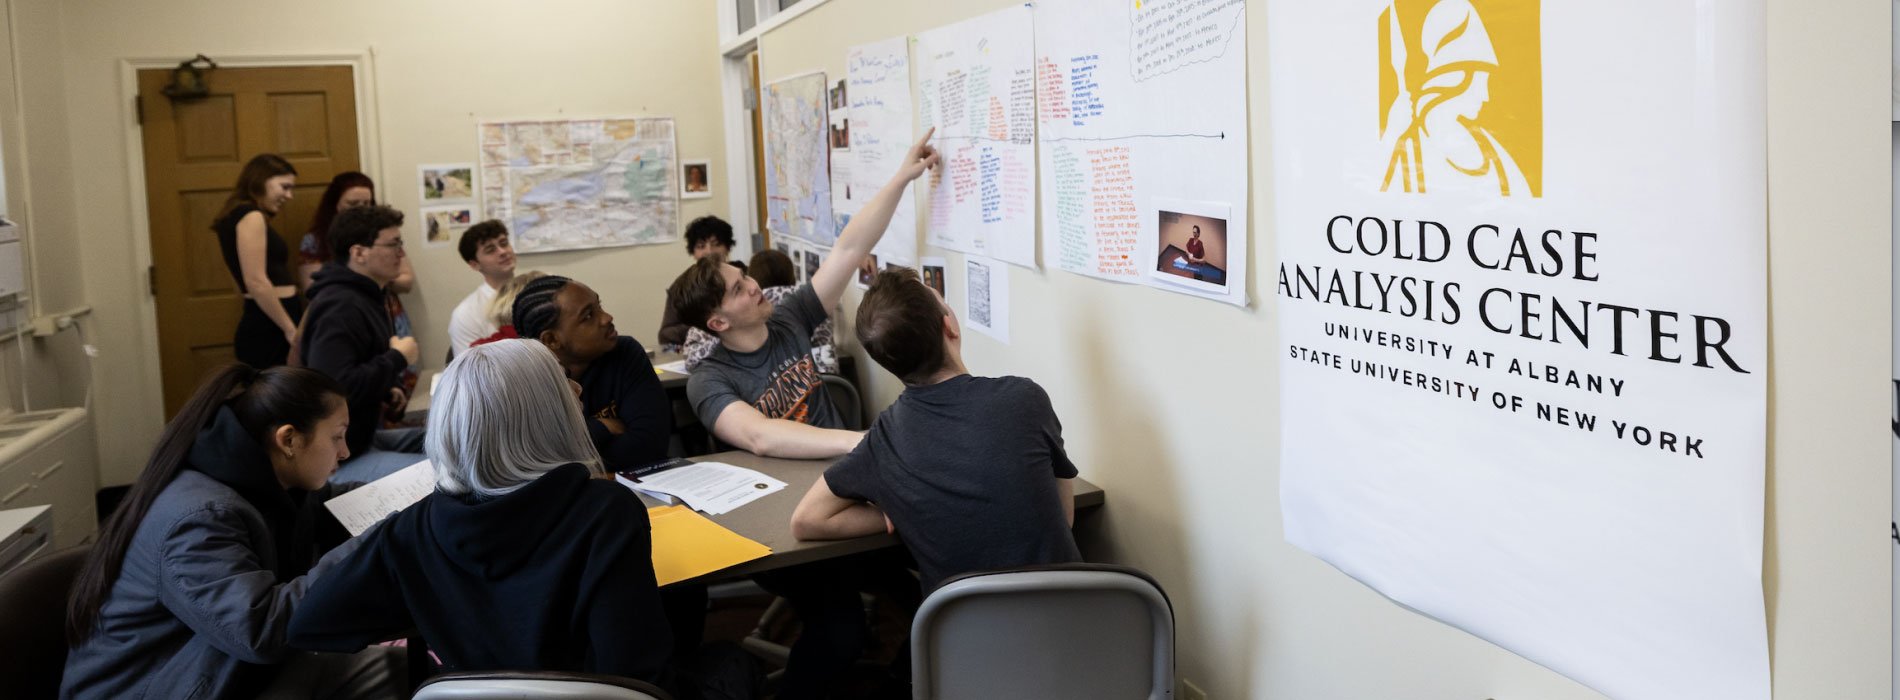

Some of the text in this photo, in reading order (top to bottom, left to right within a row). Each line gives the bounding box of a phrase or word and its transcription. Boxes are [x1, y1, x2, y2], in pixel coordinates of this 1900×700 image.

[1326, 215, 1599, 282] COLD CASE
[1277, 261, 1751, 374] ANALYSIS CENTER
[1324, 322, 1624, 397] UNIVERSITY AT ALBANY
[1290, 345, 1704, 459] STATE UNIVERSITY OF NEW YORK
